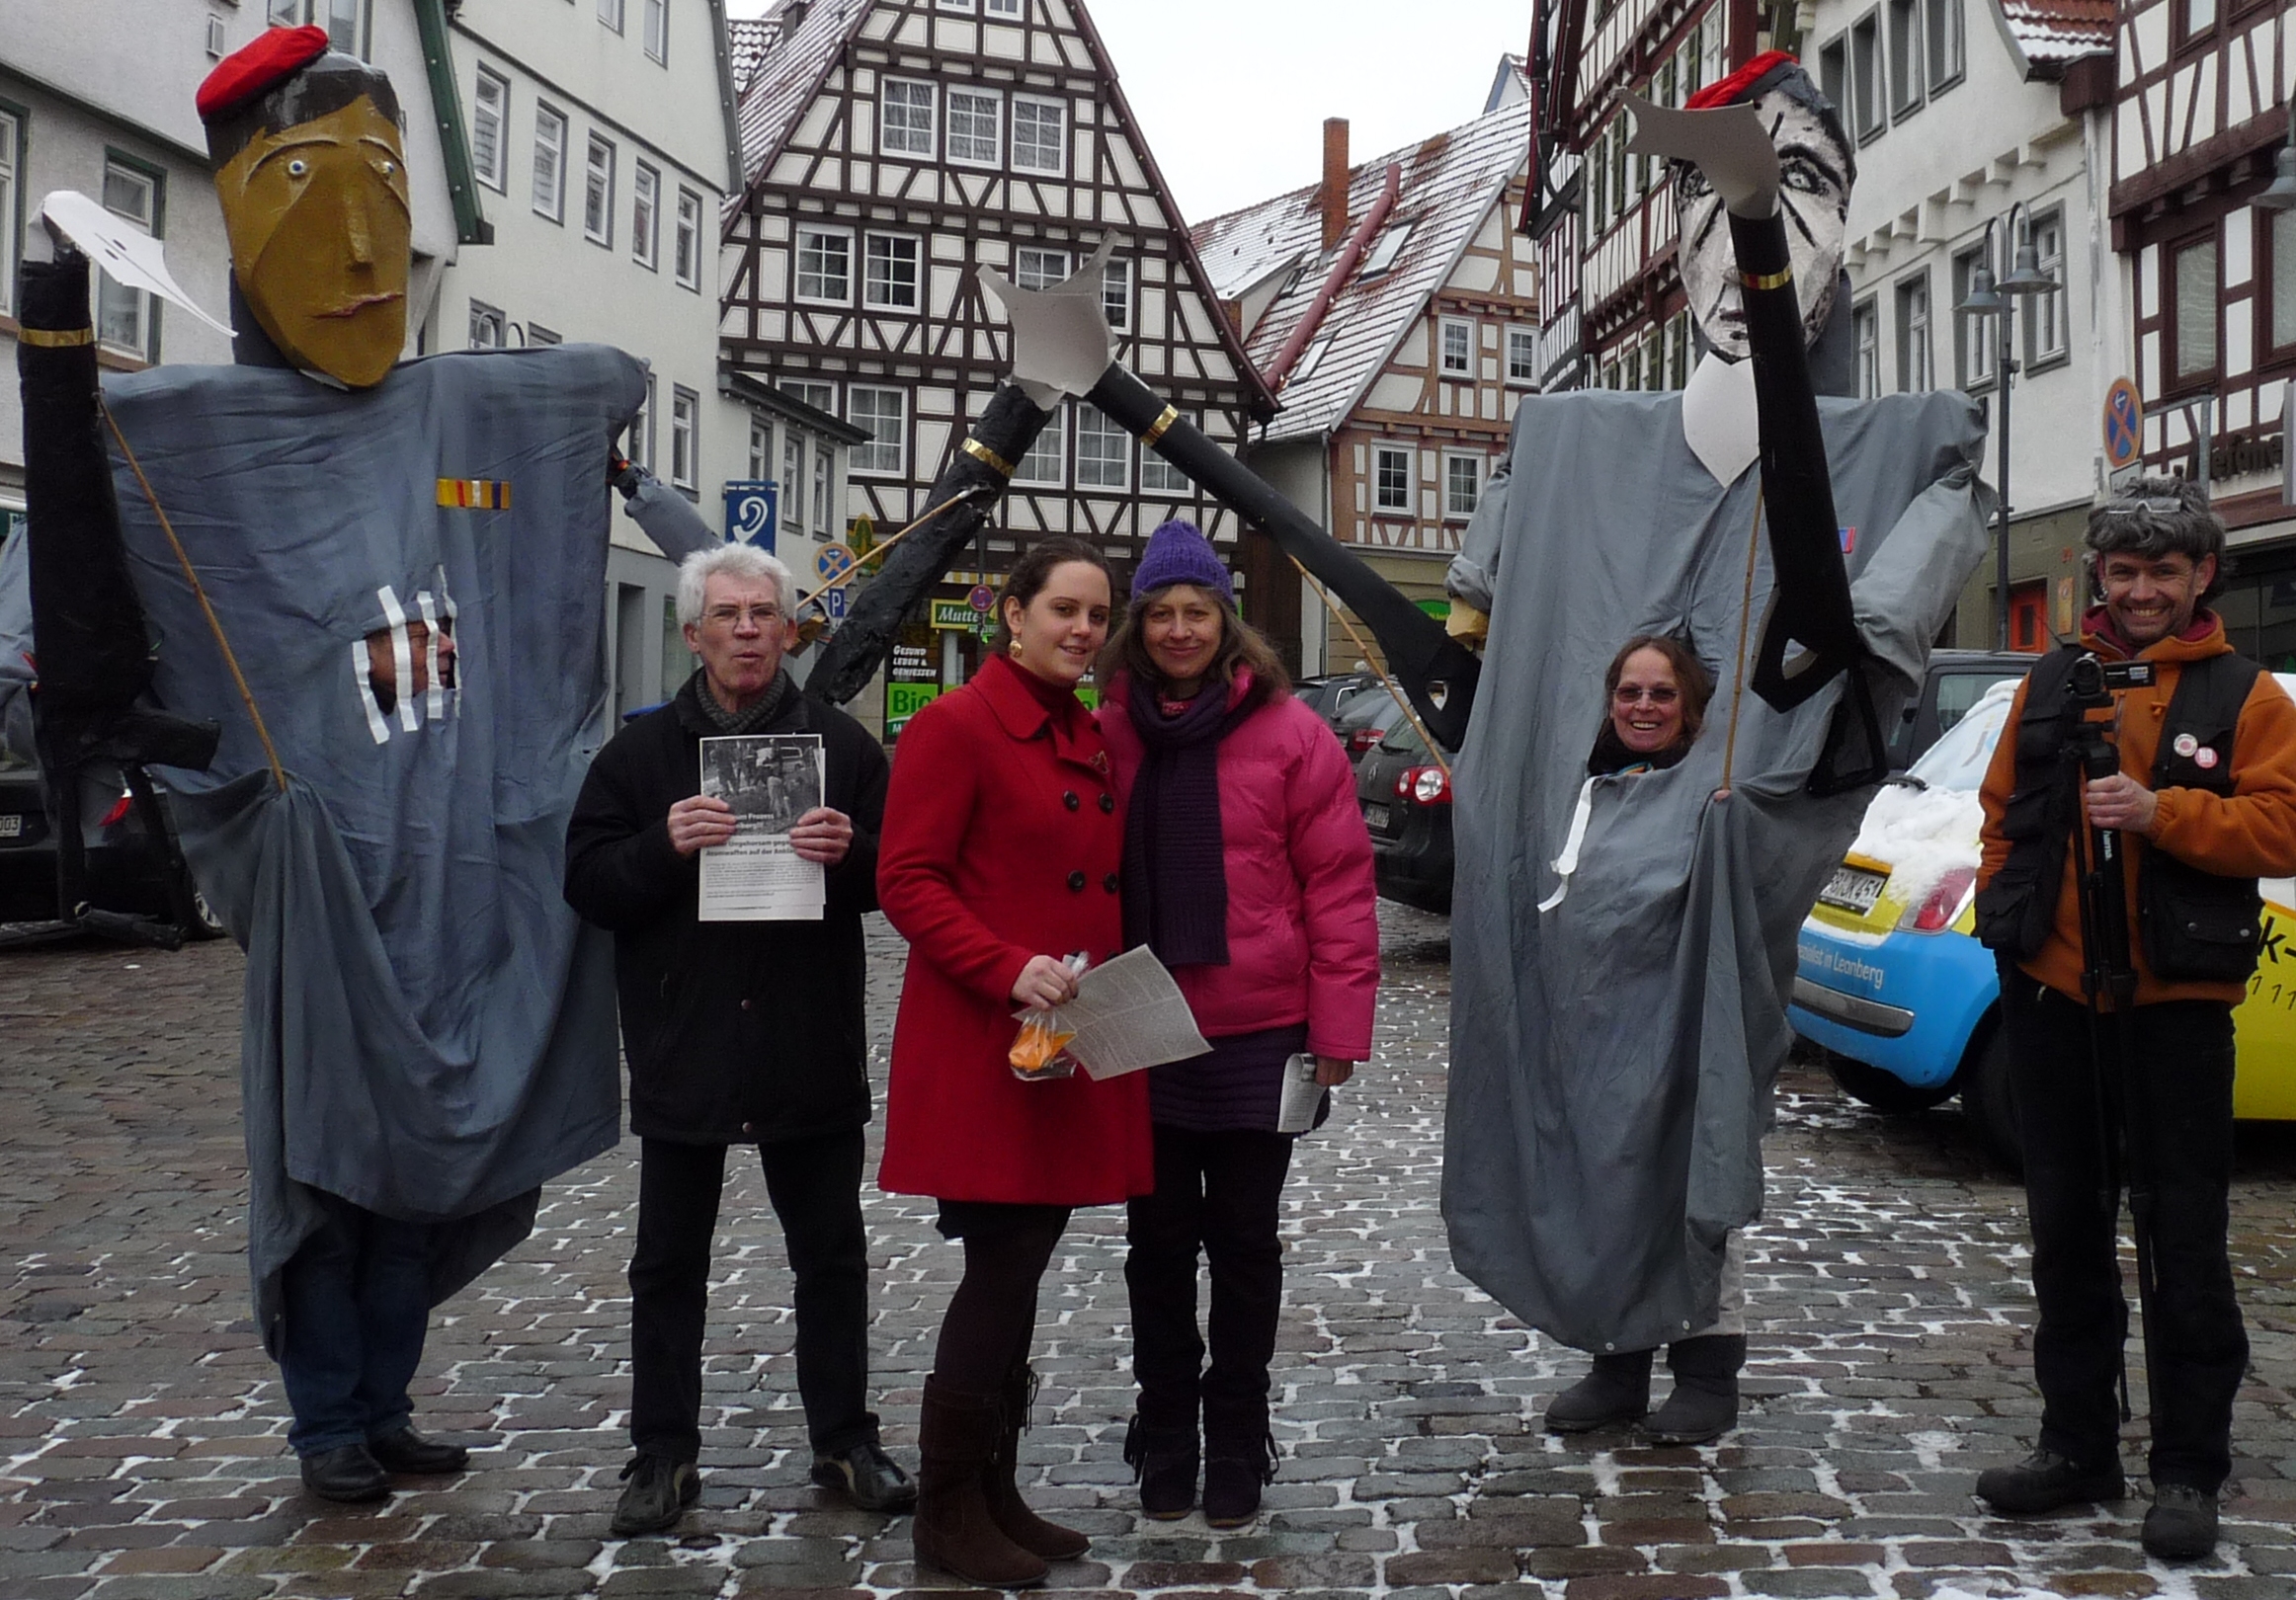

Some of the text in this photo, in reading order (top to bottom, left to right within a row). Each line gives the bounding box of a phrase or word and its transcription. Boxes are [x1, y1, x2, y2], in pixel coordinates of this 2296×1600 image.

[832, 592, 842, 616] P
[938, 606, 986, 622] Mutte
[1834, 951, 1884, 990] Leonberg
